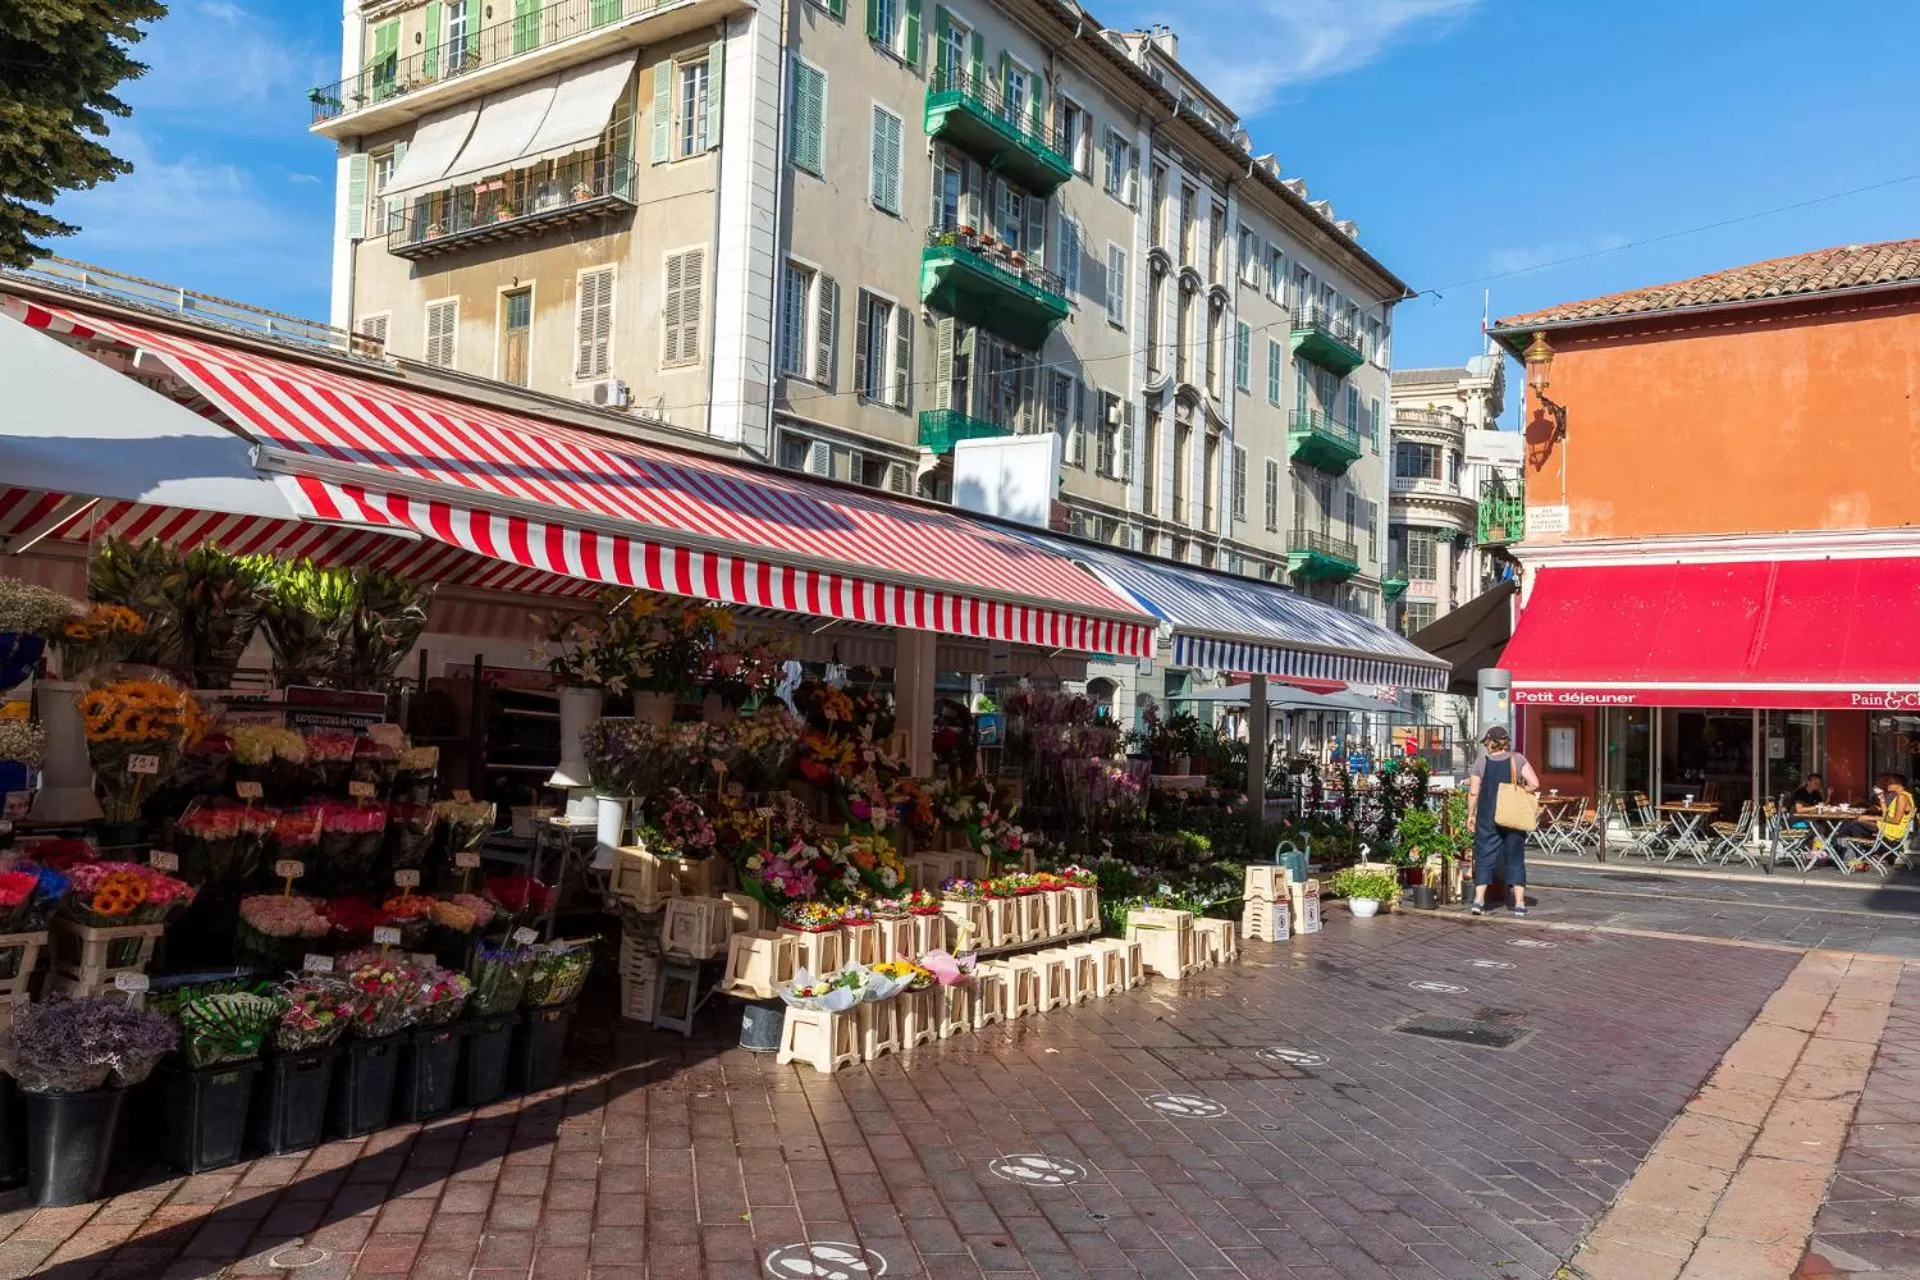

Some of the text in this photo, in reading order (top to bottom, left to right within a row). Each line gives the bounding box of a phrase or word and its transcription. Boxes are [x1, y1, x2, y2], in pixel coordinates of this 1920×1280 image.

[1515, 692, 1636, 704] Petit déjeuner
[1851, 693, 1883, 705] Pain
